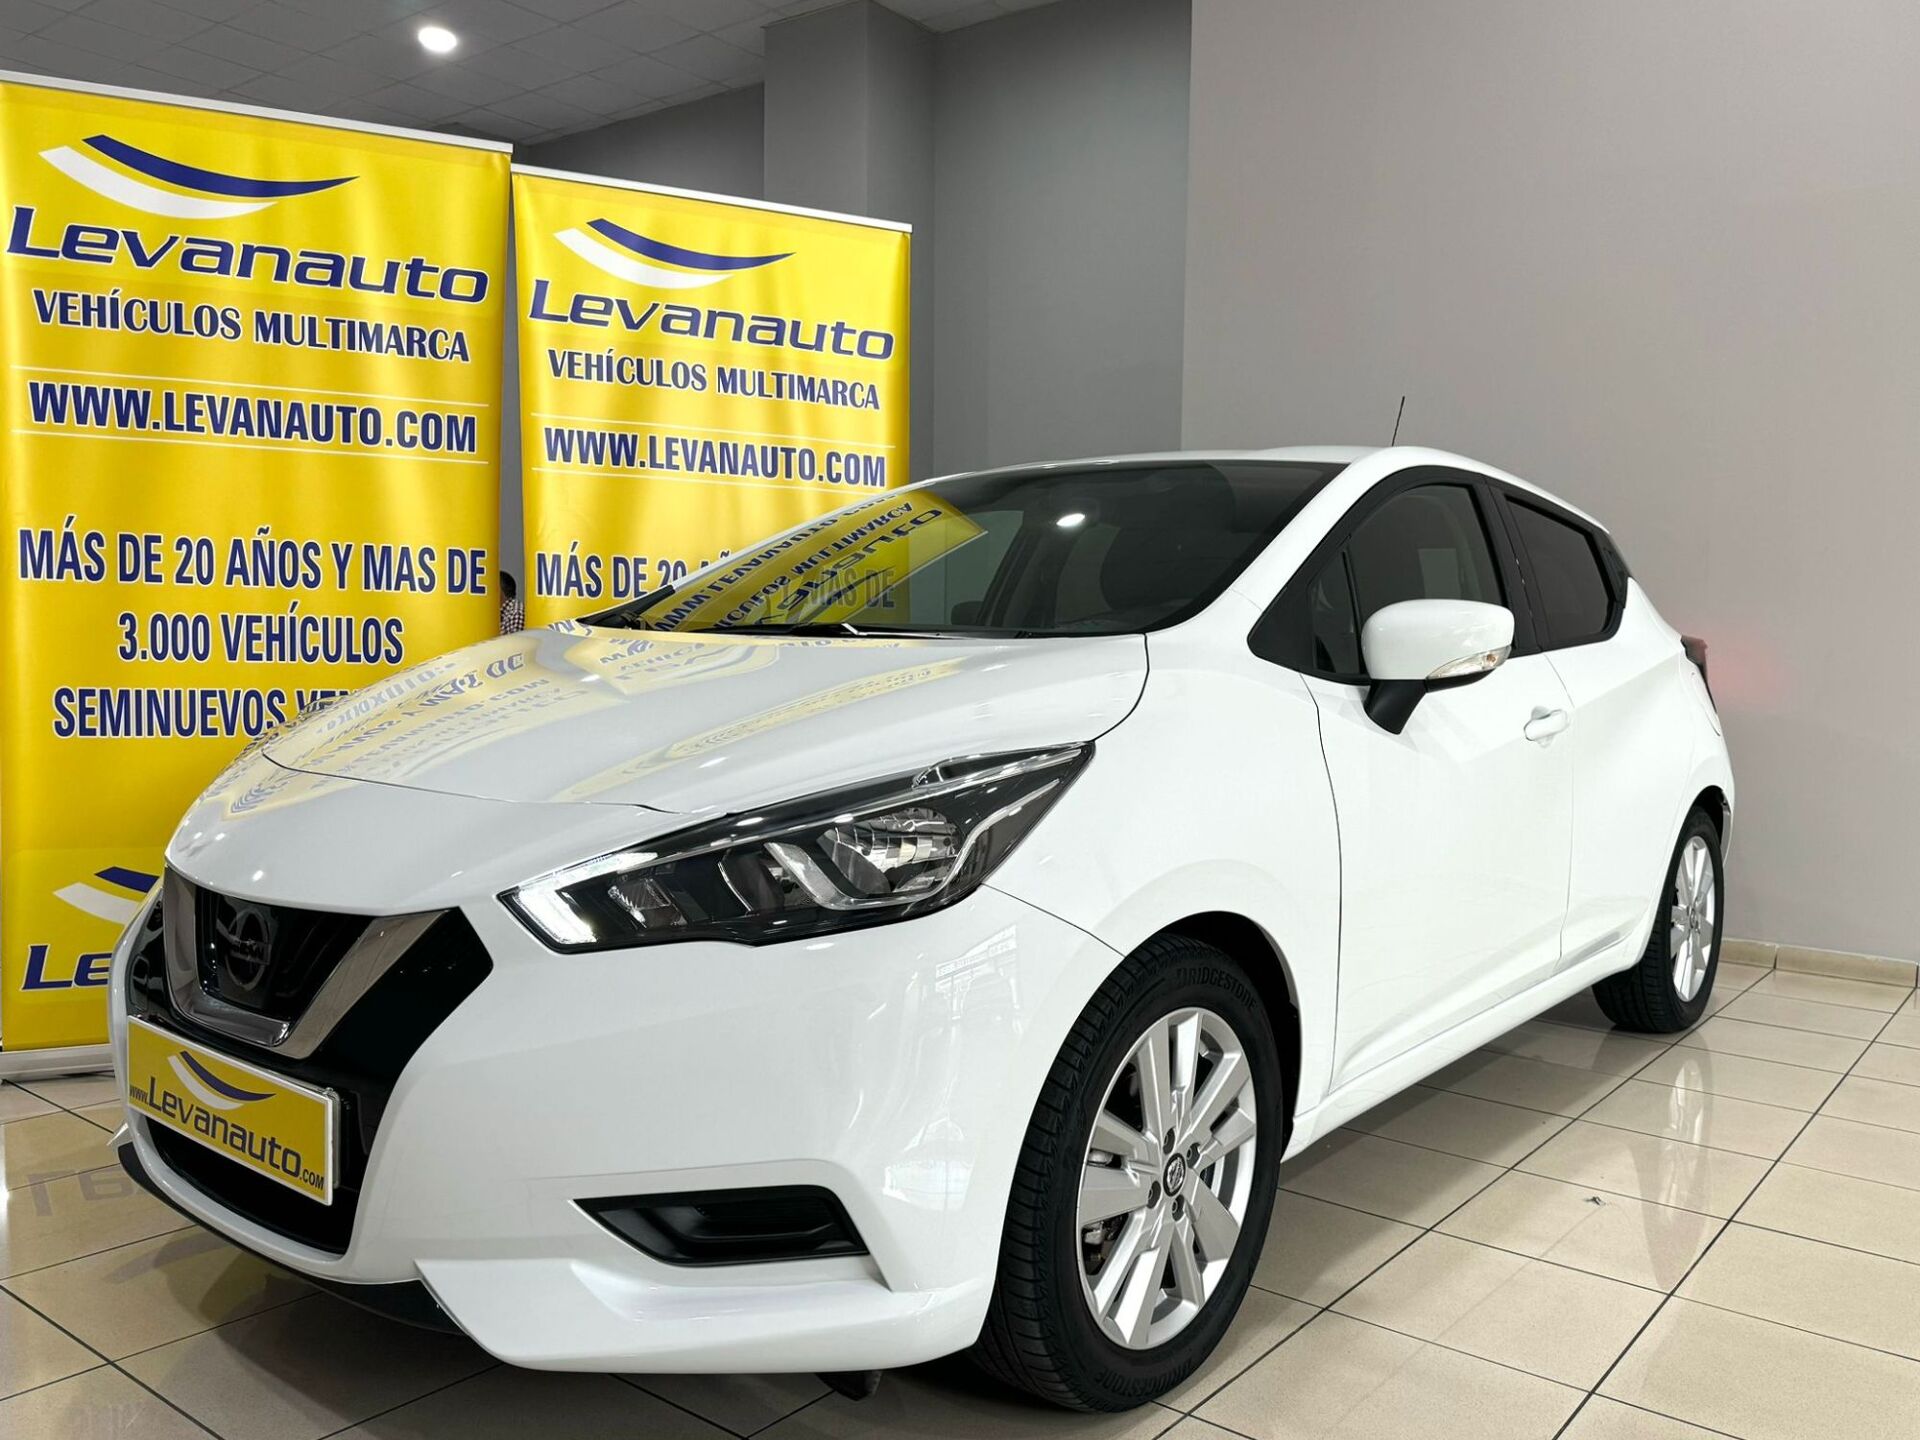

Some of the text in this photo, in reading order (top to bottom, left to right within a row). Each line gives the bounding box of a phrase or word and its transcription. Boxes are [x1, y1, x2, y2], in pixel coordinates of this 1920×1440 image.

[7, 207, 489, 303] Levanauto
[33, 289, 470, 362] VEHÍCULOS MULTIMARCA
[529, 279, 894, 360] Levanauto
[548, 349, 880, 410] VEHÍCULOS MULTIMARCA
[29, 382, 476, 452] WWW.LEVANAUTO.COM
[544, 427, 886, 487] WWW.LEVANAUTO.COM
[19, 516, 486, 595] MÁS DE 20 AÑOS Y MAS DE
[537, 541, 602, 598] MÁS
[613, 556, 648, 598] DE
[118, 602, 403, 664] 3.000 VEHÍCULOS
[54, 688, 286, 738] SEMINUEVOS
[1176, 966, 1258, 1009] BRIDGESTONE
